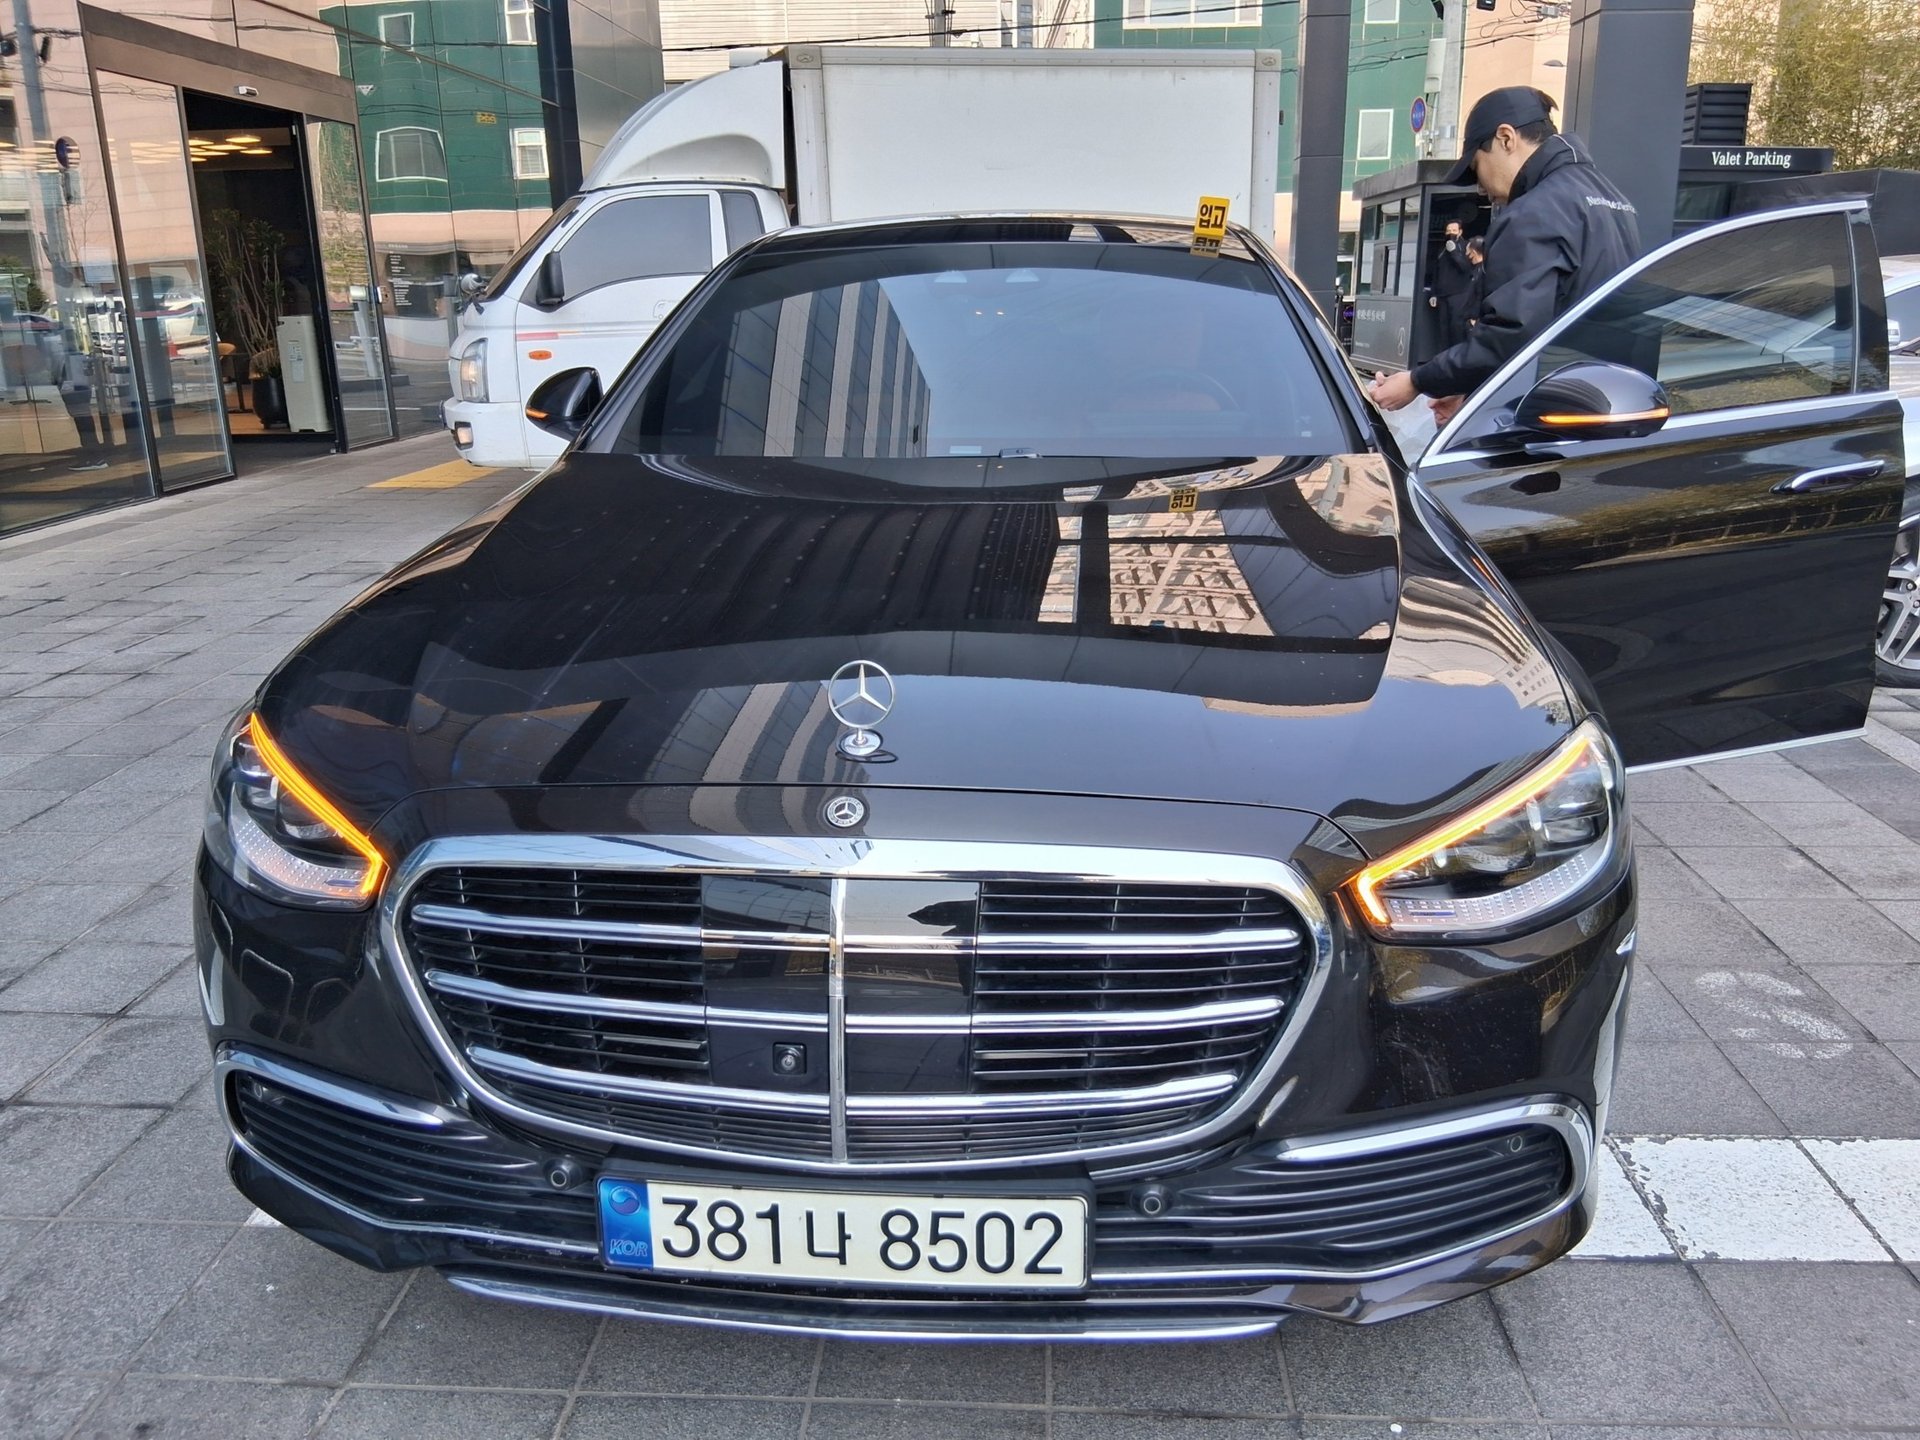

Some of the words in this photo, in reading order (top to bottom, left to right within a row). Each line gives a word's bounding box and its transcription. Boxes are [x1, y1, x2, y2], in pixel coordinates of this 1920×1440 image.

[1712, 152, 1741, 166] Valet
[1745, 152, 1791, 168] Parking
[1199, 204, 1226, 229] 입고
[609, 1239, 648, 1256] KOR
[880, 1208, 1063, 1275] 8502
